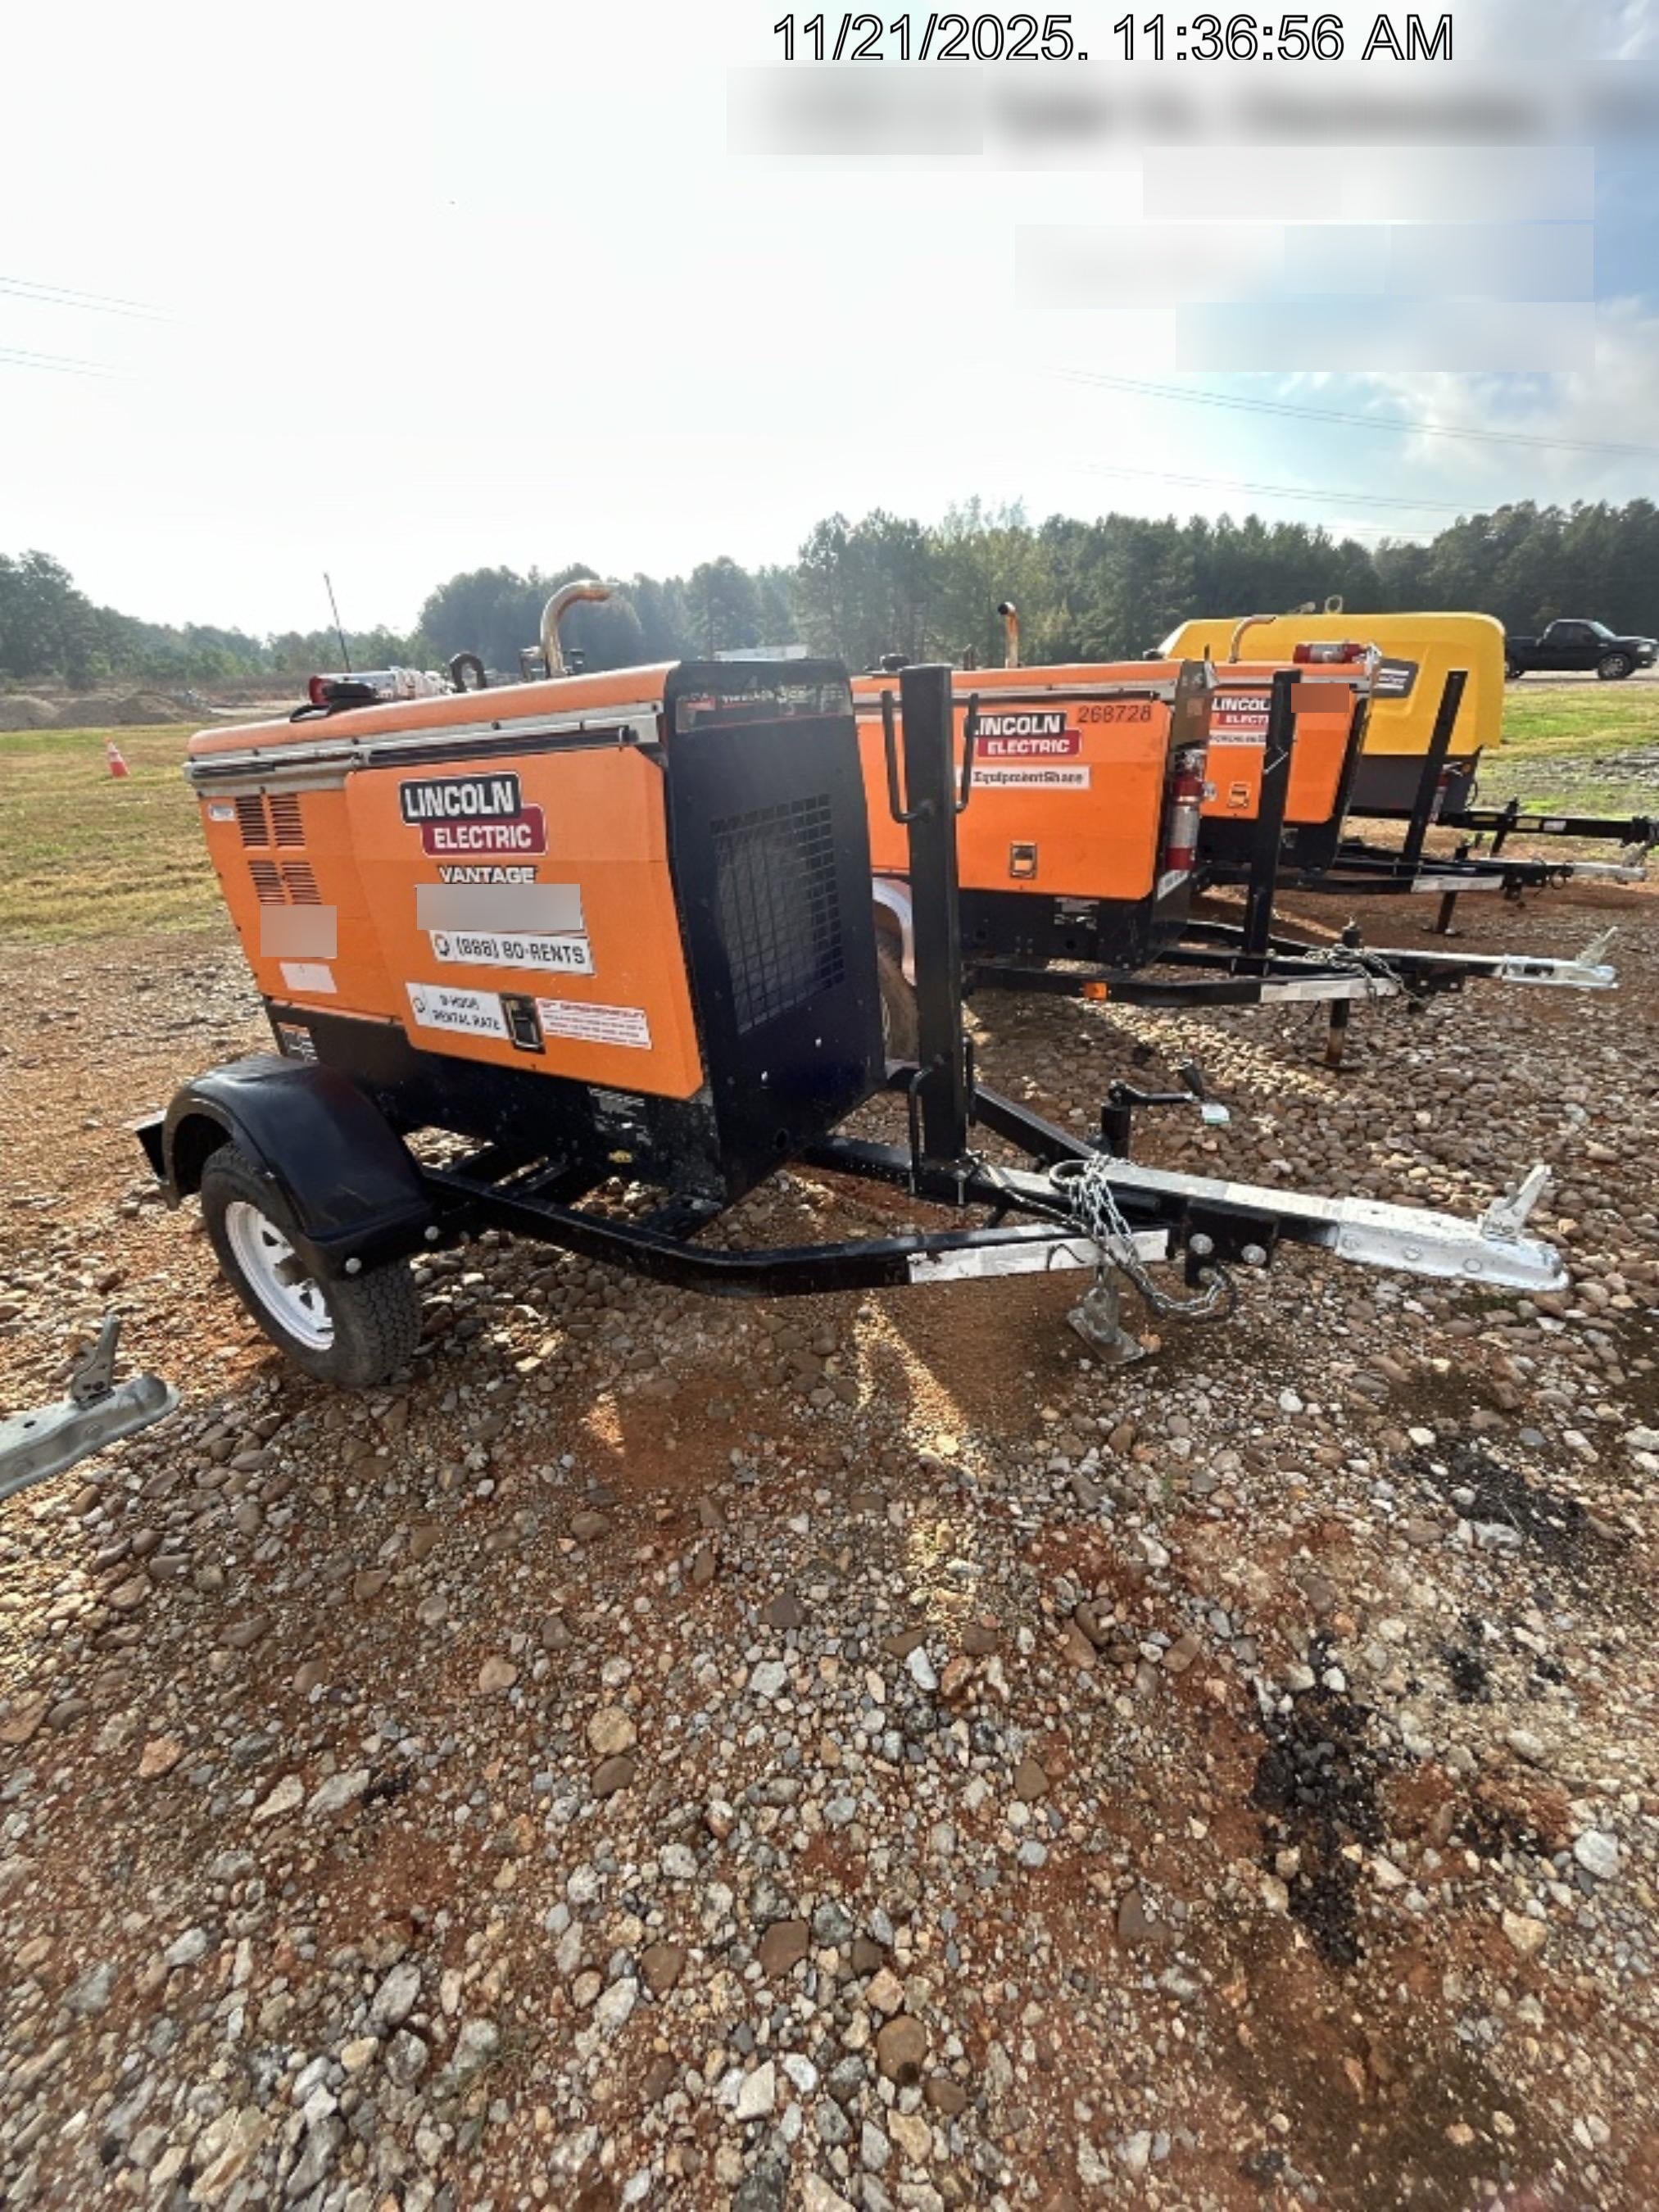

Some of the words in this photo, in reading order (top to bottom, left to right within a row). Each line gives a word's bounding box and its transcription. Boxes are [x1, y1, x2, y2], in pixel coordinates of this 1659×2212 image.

[1212, 697, 1271, 711] LINCOL
[1077, 705, 1152, 723] 268728
[975, 714, 1061, 736] INCOLN
[987, 739, 1070, 755] ELECTRIC
[973, 771, 1083, 784] EquipmentShare
[405, 781, 514, 818] LINCOLN
[433, 823, 532, 850] ELECTRIC
[438, 865, 537, 884] VANTAGE
